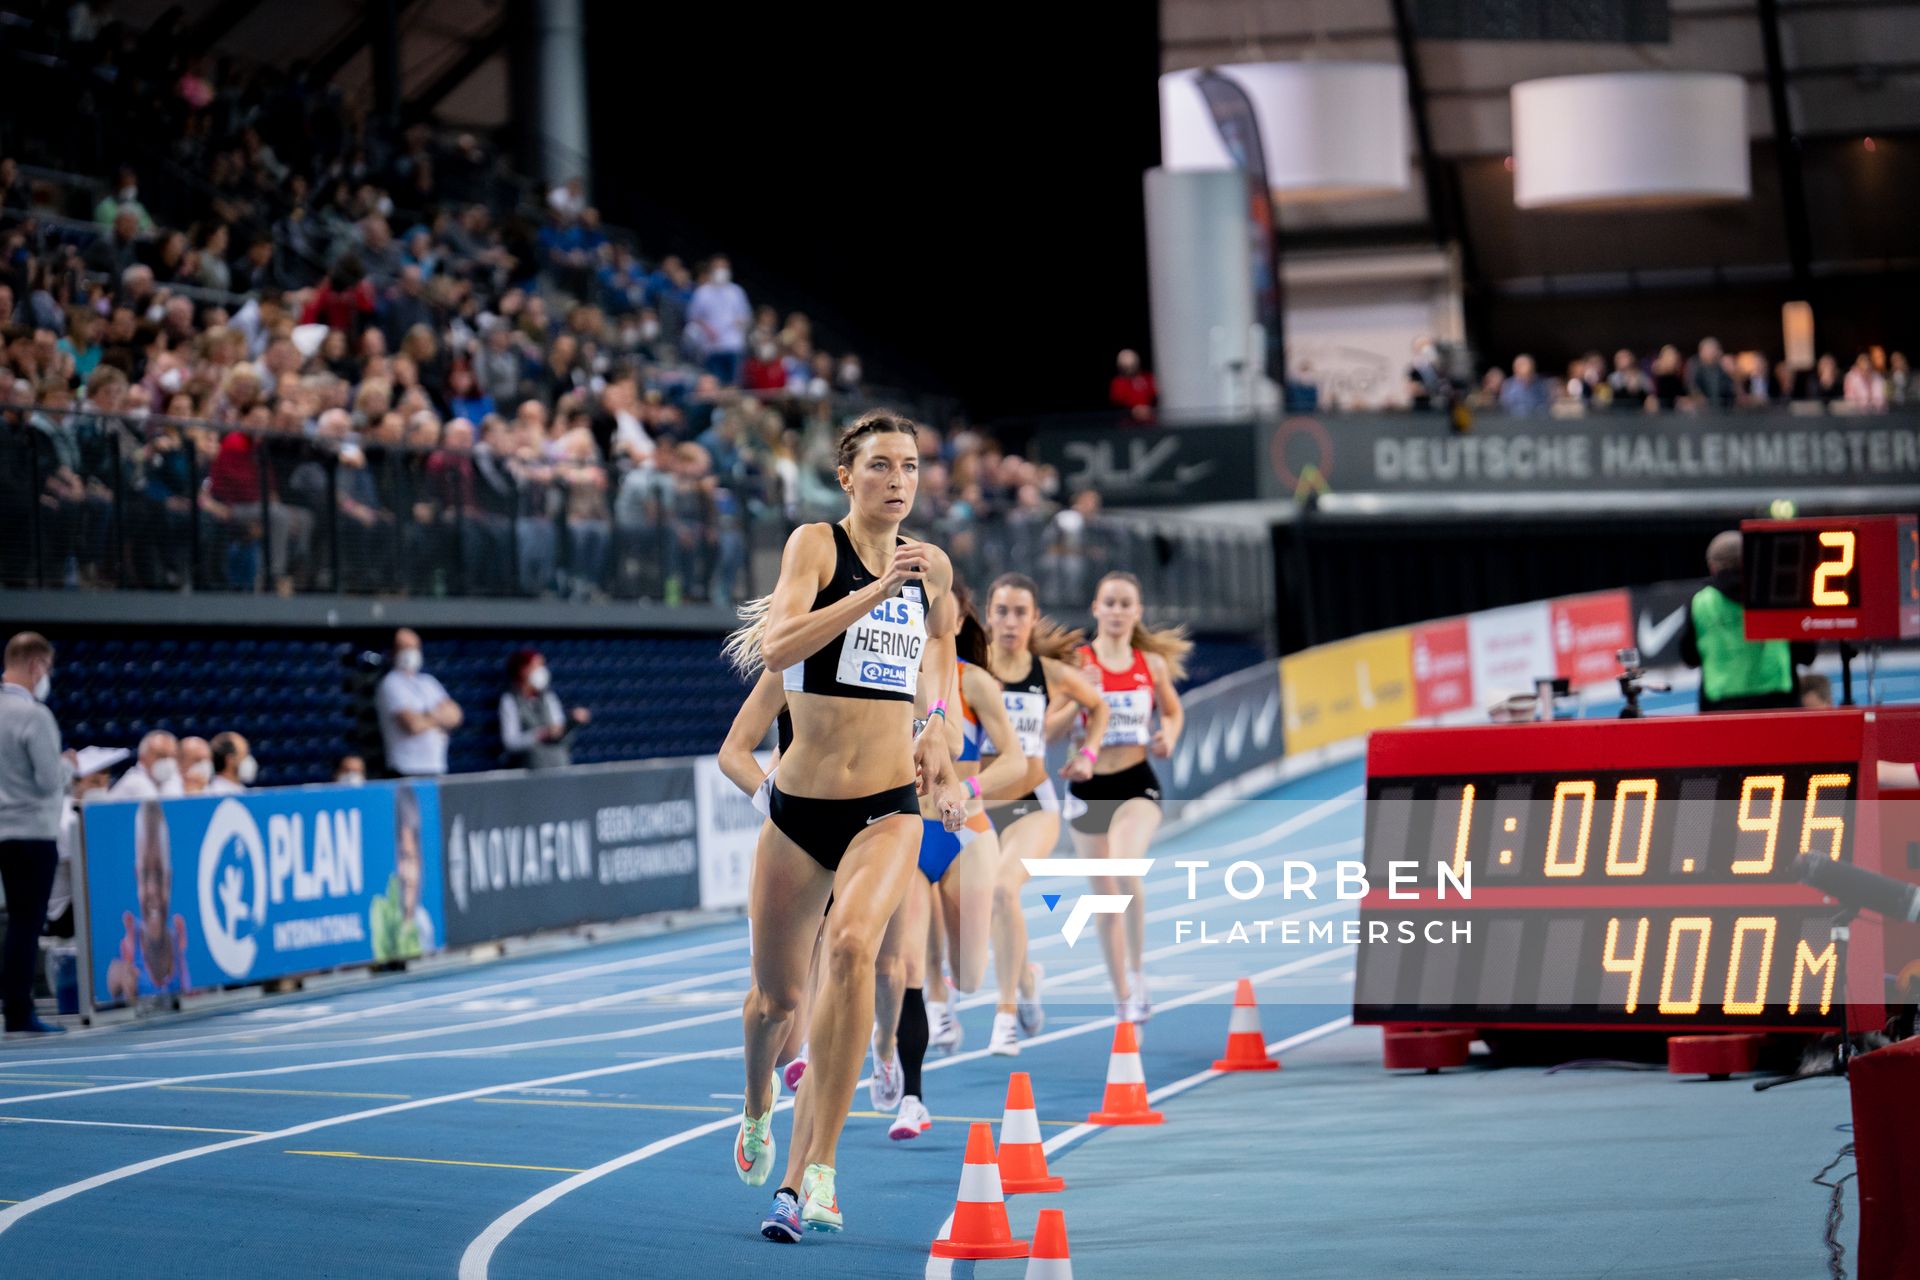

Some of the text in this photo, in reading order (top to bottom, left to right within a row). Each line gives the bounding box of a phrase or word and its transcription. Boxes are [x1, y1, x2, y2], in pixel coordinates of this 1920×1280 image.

[1373, 429, 1920, 481] DEUTSCHE HALLENMEISTER
[1812, 531, 1855, 606] 2
[853, 627, 921, 660] HERING
[268, 807, 364, 905] PLAN
[468, 818, 594, 893] NOVAFON
[1453, 773, 1851, 878] 1:00.96
[1602, 917, 1839, 1015] 400M
